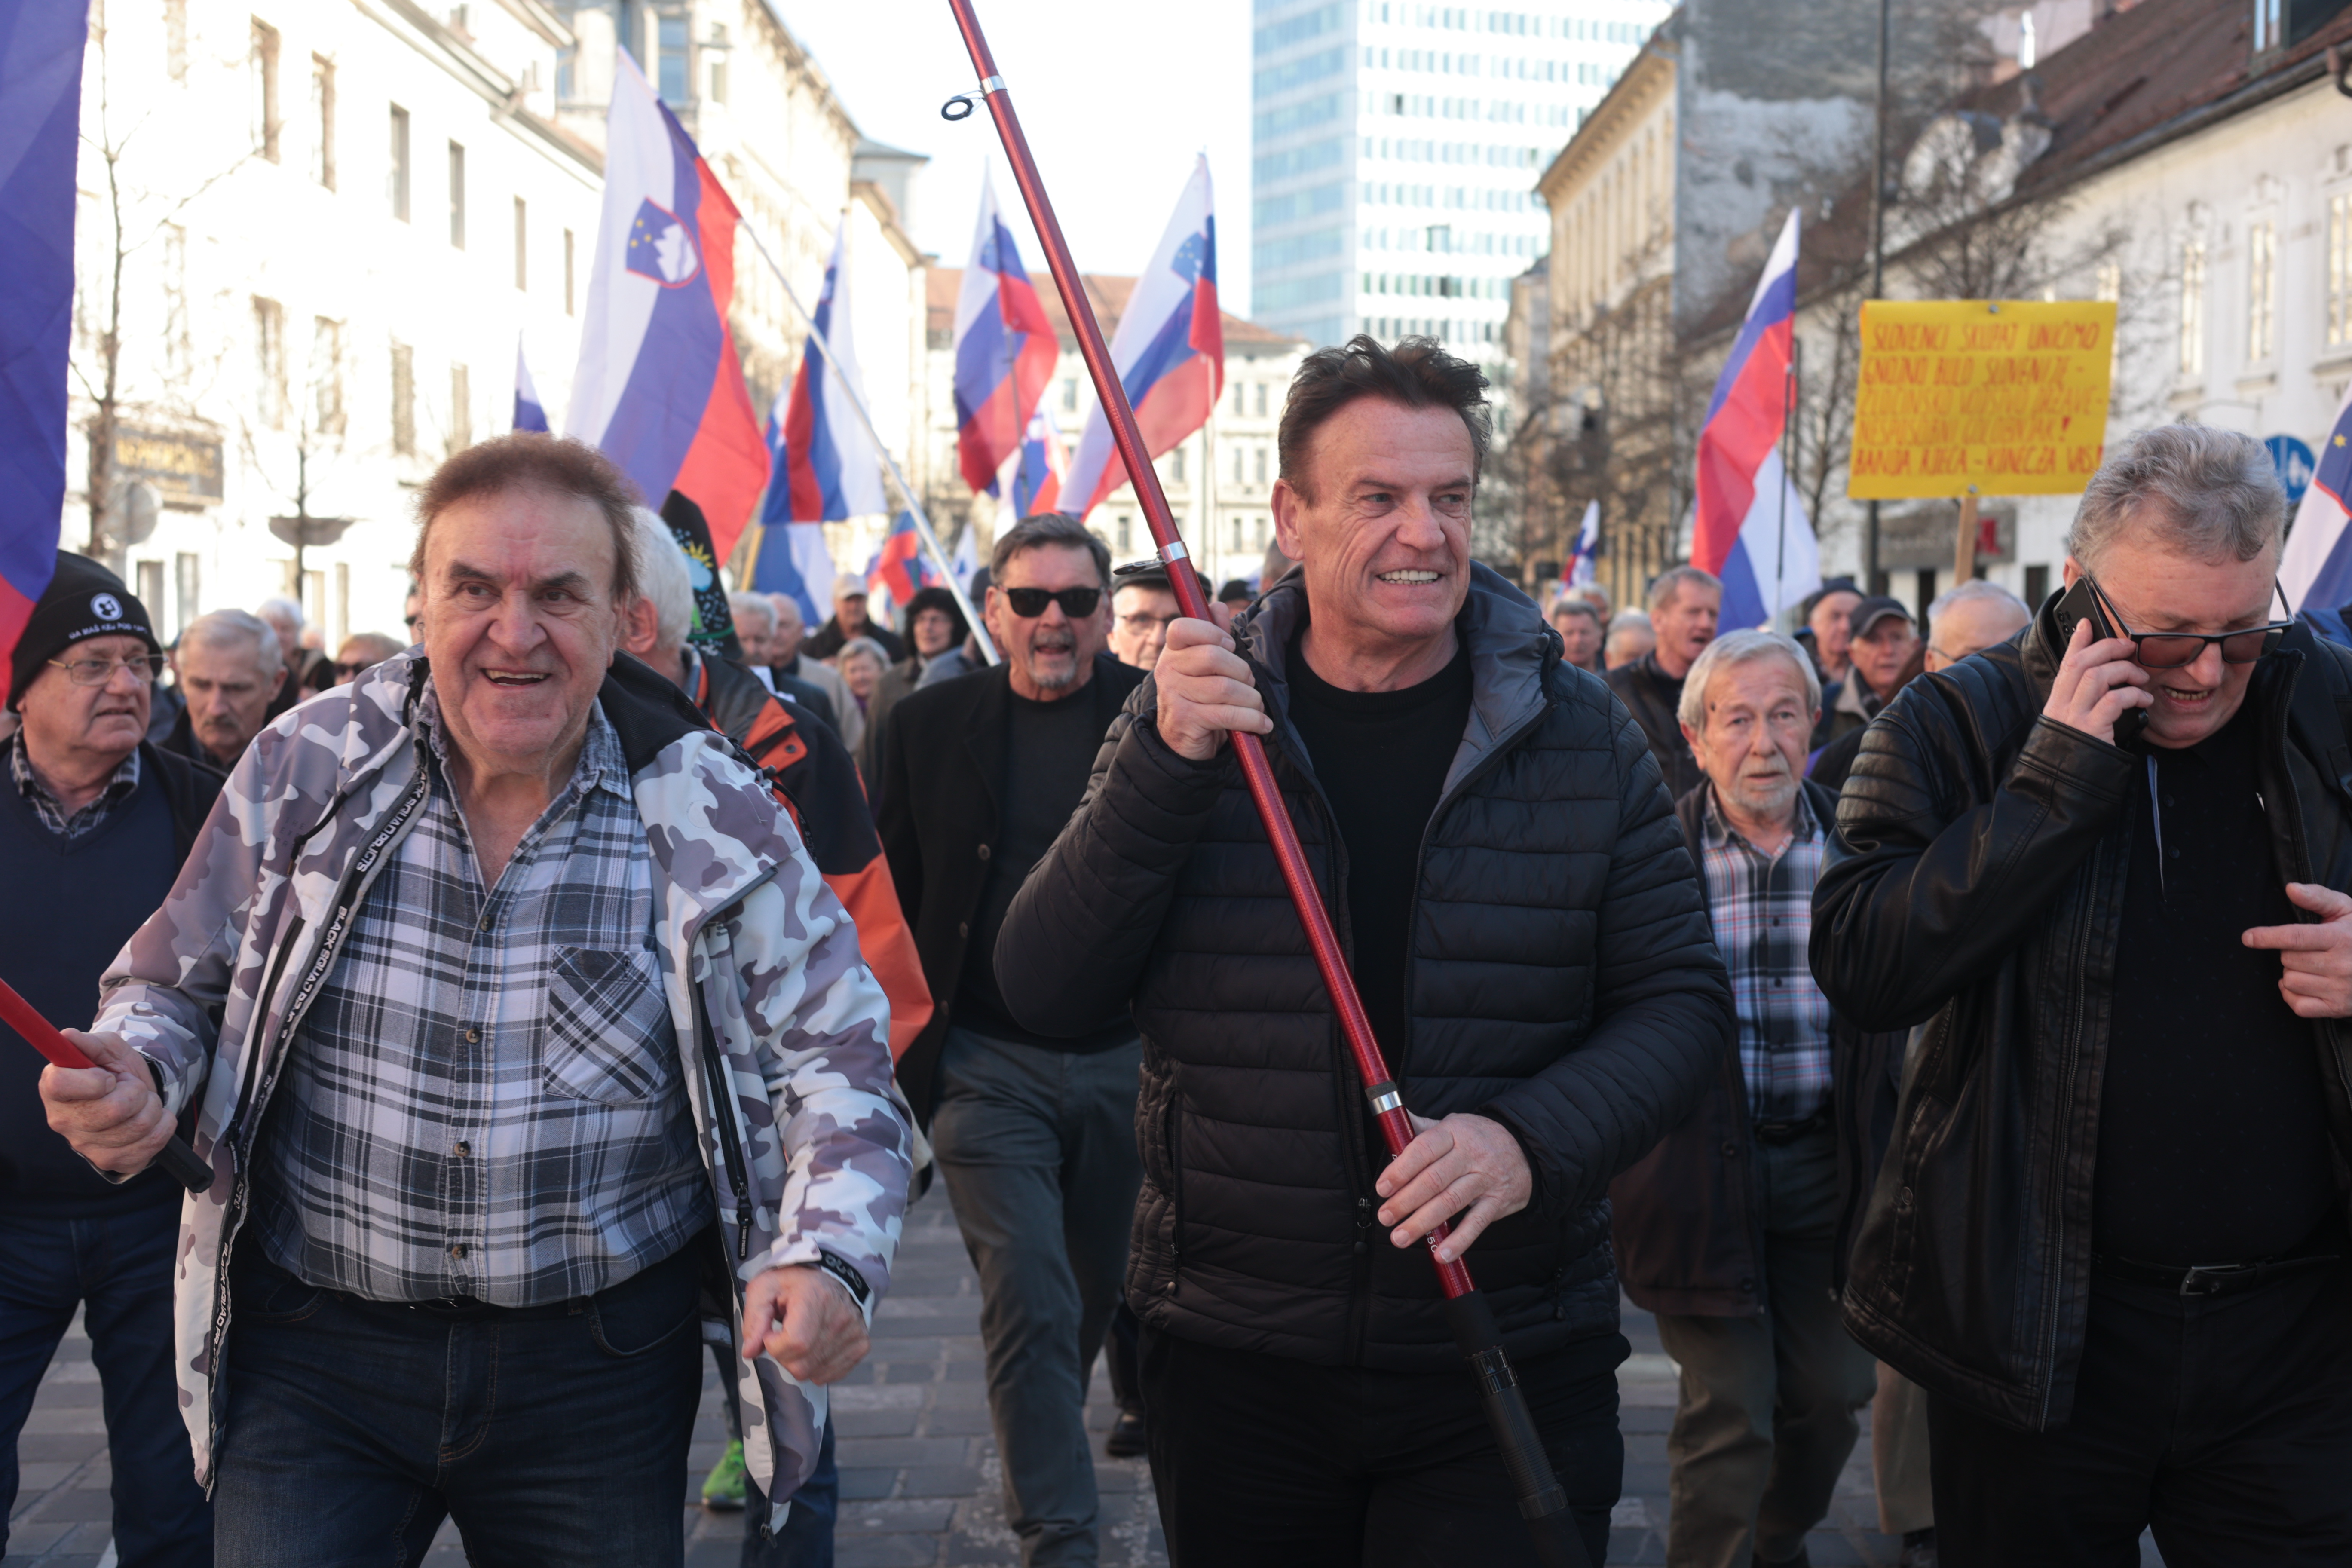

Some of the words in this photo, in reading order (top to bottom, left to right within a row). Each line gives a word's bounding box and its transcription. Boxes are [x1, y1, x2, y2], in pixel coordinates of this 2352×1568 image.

[383, 798, 417, 835] SQUAD
[356, 832, 390, 872] PRJCTS
[323, 905, 348, 949] BLACK
[217, 1283, 227, 1327] SQUAD
